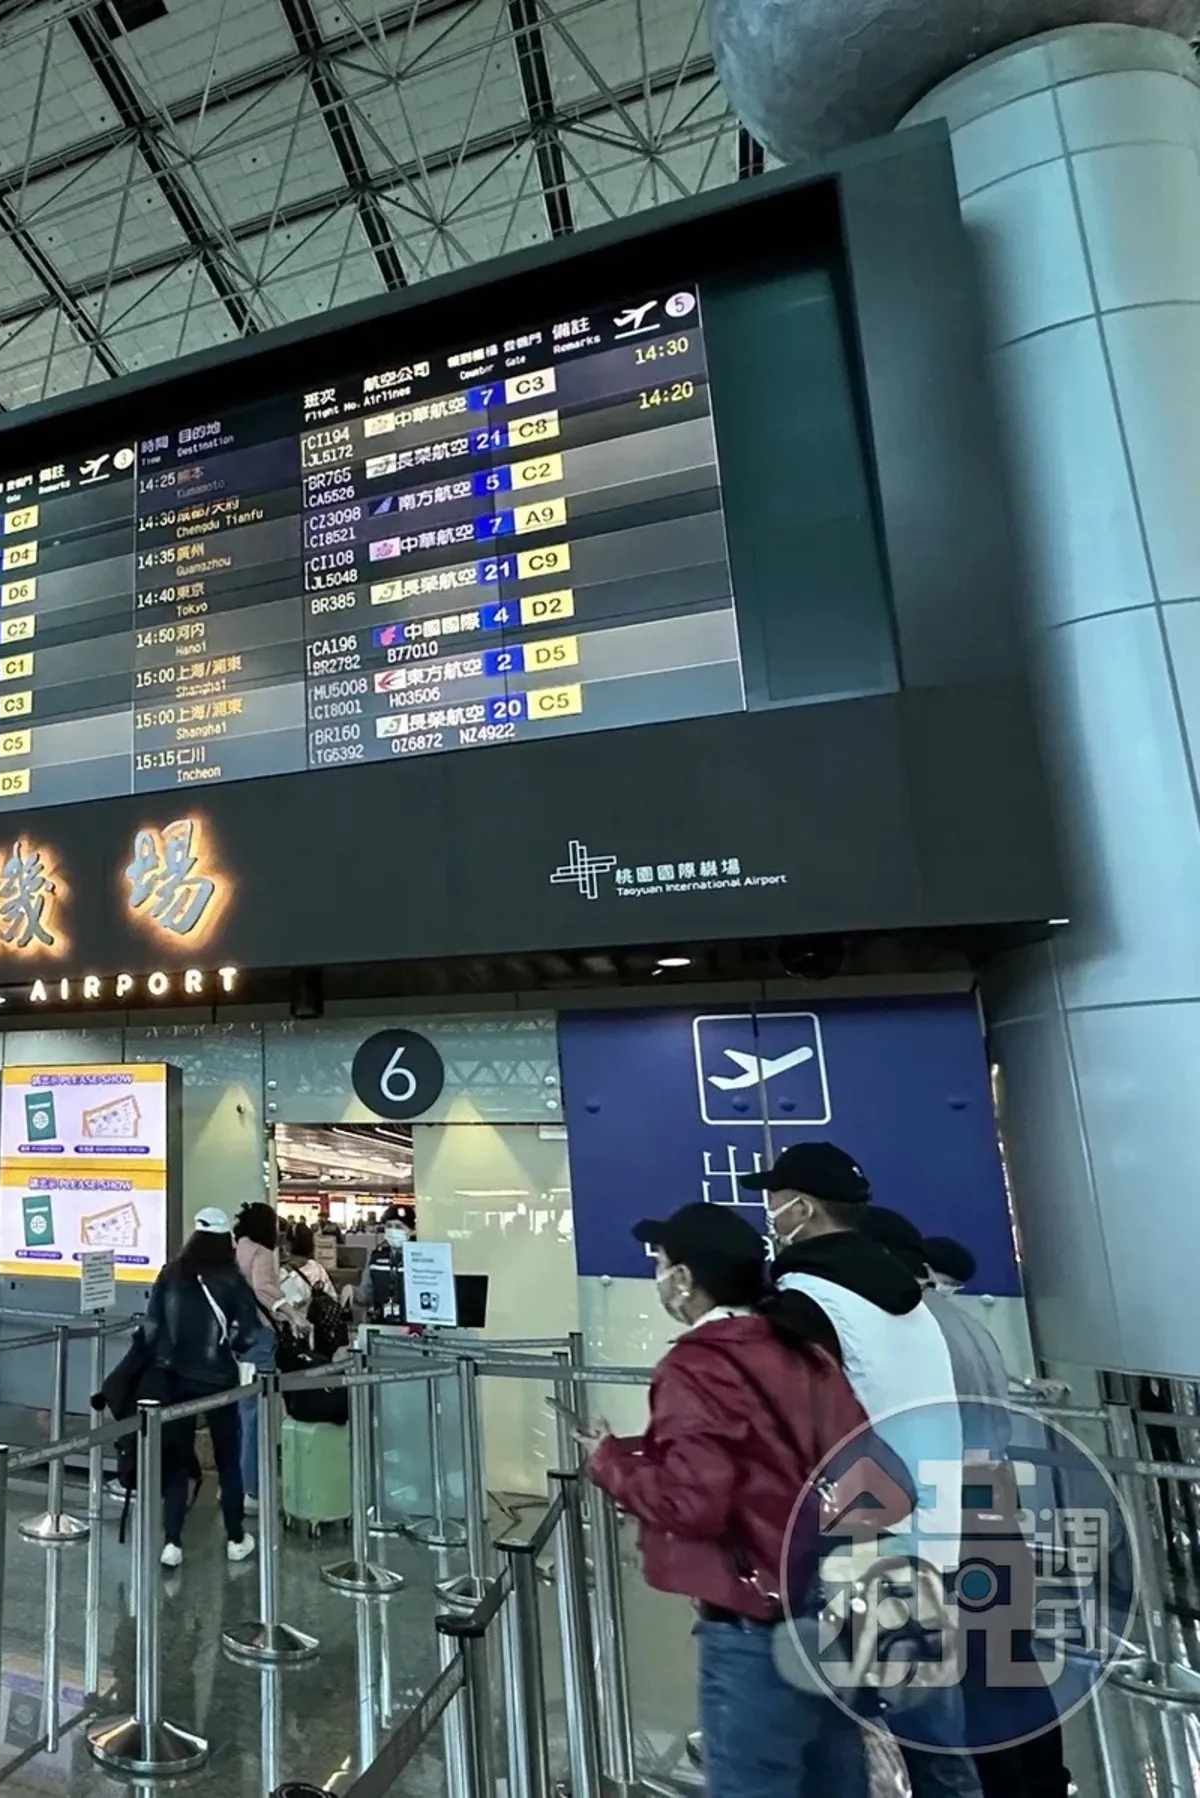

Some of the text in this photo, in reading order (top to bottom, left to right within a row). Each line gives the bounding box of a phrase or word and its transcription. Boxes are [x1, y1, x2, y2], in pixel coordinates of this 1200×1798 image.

[674, 296, 685, 313] 5
[304, 388, 336, 409] 班次
[363, 361, 430, 393] 航空公司
[305, 405, 340, 422] Flight
[363, 386, 411, 407] Airlines
[505, 354, 527, 367] Gate
[553, 334, 601, 354] Remarks
[307, 336, 689, 450] CI194 中華航空 7 C3 14:30
[178, 421, 221, 444] 目的地
[308, 381, 693, 490] BR765 長榮航空 21 C8 14:20
[177, 434, 234, 457] Destination
[308, 445, 354, 467] JL5172
[139, 472, 176, 494] 14:25
[309, 486, 355, 508] CA5526
[310, 463, 551, 531] CZ3098 南方航空 5 C2
[11, 512, 31, 527] C7
[138, 510, 175, 532] 14:30
[176, 508, 264, 539] Chengdu Tianfu
[310, 527, 356, 548] CI8521
[311, 507, 554, 572] CI108 中華航空 7 A9
[10, 549, 29, 564] D4
[138, 548, 175, 569] 14:35
[176, 556, 231, 577] Guangzhou
[310, 569, 357, 591] JL5048
[311, 552, 558, 615] BR385 長榮航空 21 C9
[8, 585, 28, 600] D6
[137, 588, 175, 608] 14:40
[176, 602, 208, 617] Tokyo
[7, 622, 27, 636] C2
[136, 628, 175, 648] 14:50
[313, 598, 562, 657] CA196 中國國際 4 D2
[176, 640, 207, 656] Hanoi
[313, 641, 438, 676] BR2782 B77010
[5, 661, 24, 675] C1
[136, 667, 175, 687] 15:00
[314, 645, 566, 701] MU5008 東方航空 2 D5
[176, 679, 227, 698] Shanghai
[4, 697, 25, 712] C3
[314, 699, 363, 720] CI8001
[136, 709, 175, 729] 15:00
[314, 692, 569, 745] BR160 長榮航空 20 C5
[176, 721, 227, 740] Shanghai
[459, 723, 515, 744] NZ4922
[2, 736, 23, 751] C5
[136, 746, 205, 771] 15:15 仁川
[1, 776, 22, 790] D5
[177, 766, 221, 782] Incheon
[615, 857, 741, 885] 桃園國際機場
[616, 874, 788, 897] Taoyuan International Airport
[29, 967, 238, 1001] AIRPORT
[60, 1075, 99, 1086] PLEASE
[100, 1074, 133, 1085] SHOW
[380, 1046, 418, 1102] 6
[59, 1179, 99, 1190] PLEASE
[100, 1180, 132, 1191] SHOW
